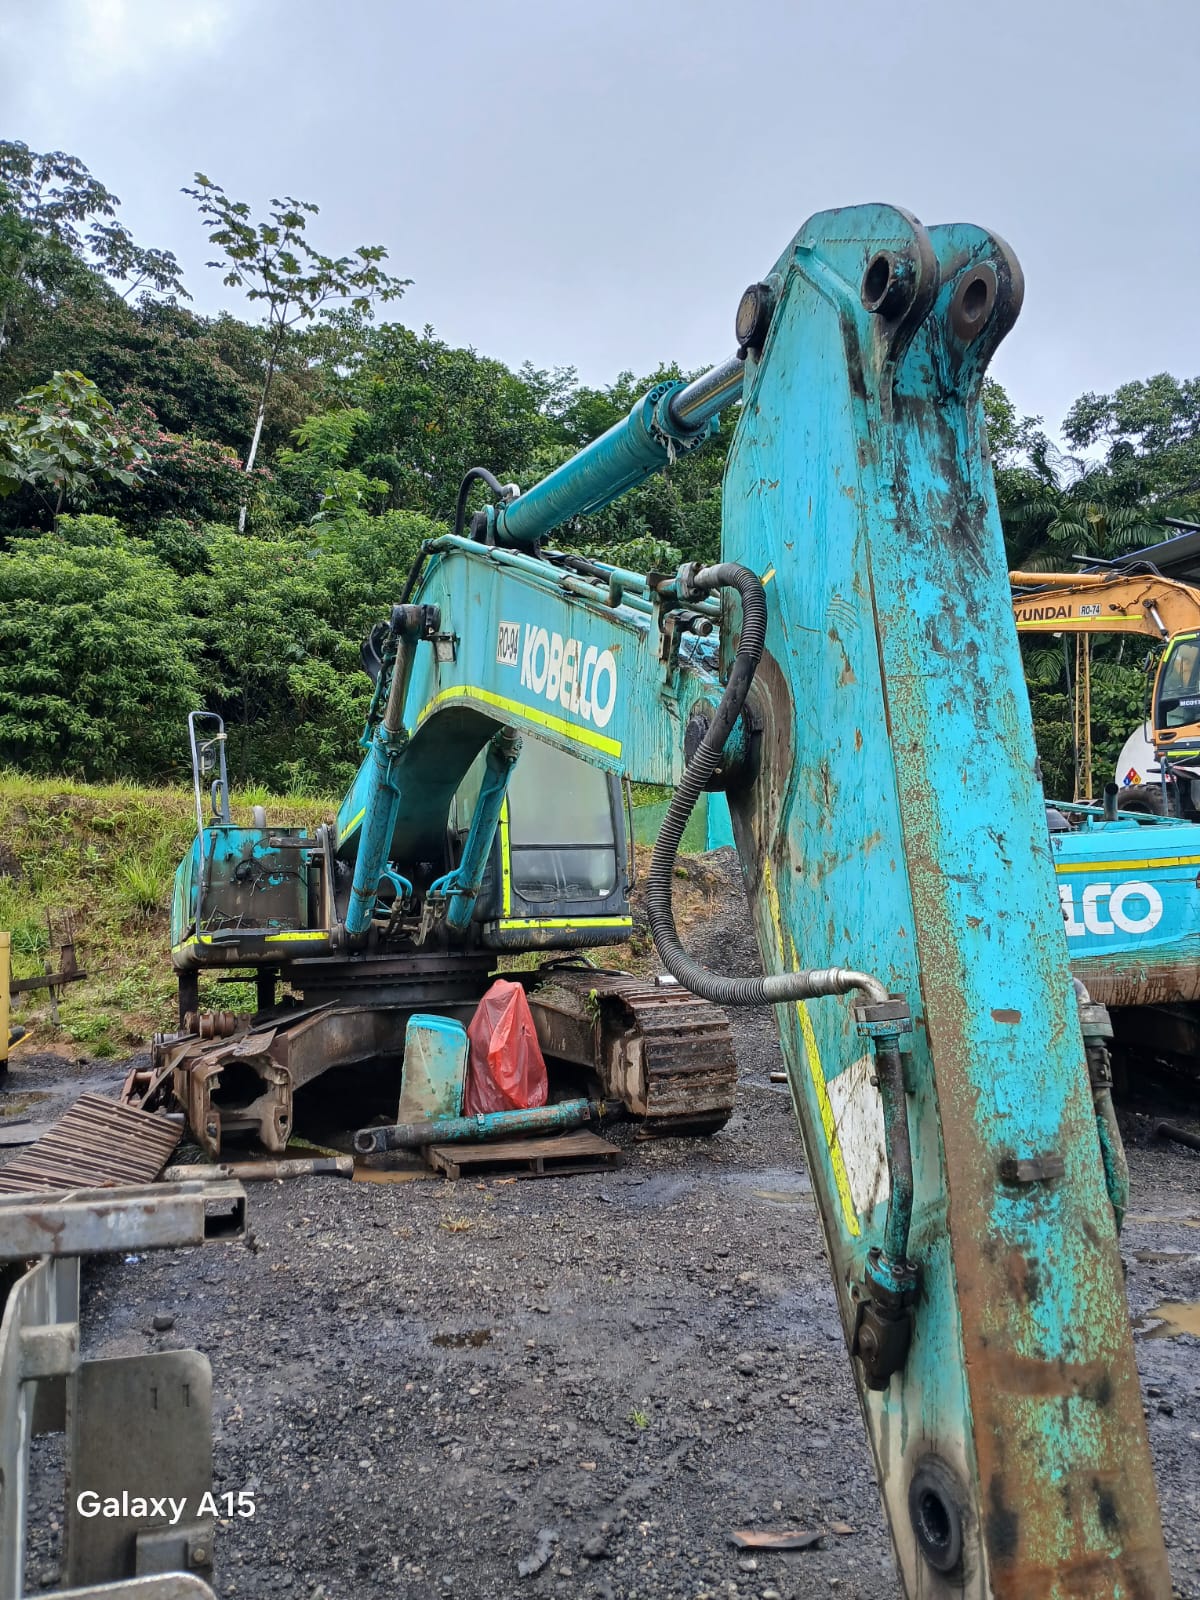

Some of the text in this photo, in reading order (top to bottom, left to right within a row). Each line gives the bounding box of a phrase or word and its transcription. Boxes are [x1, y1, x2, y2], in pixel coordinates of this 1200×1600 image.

[1081, 605, 1100, 614] RO-74
[497, 626, 519, 660] RO-94
[520, 623, 617, 728] KOBELCO
